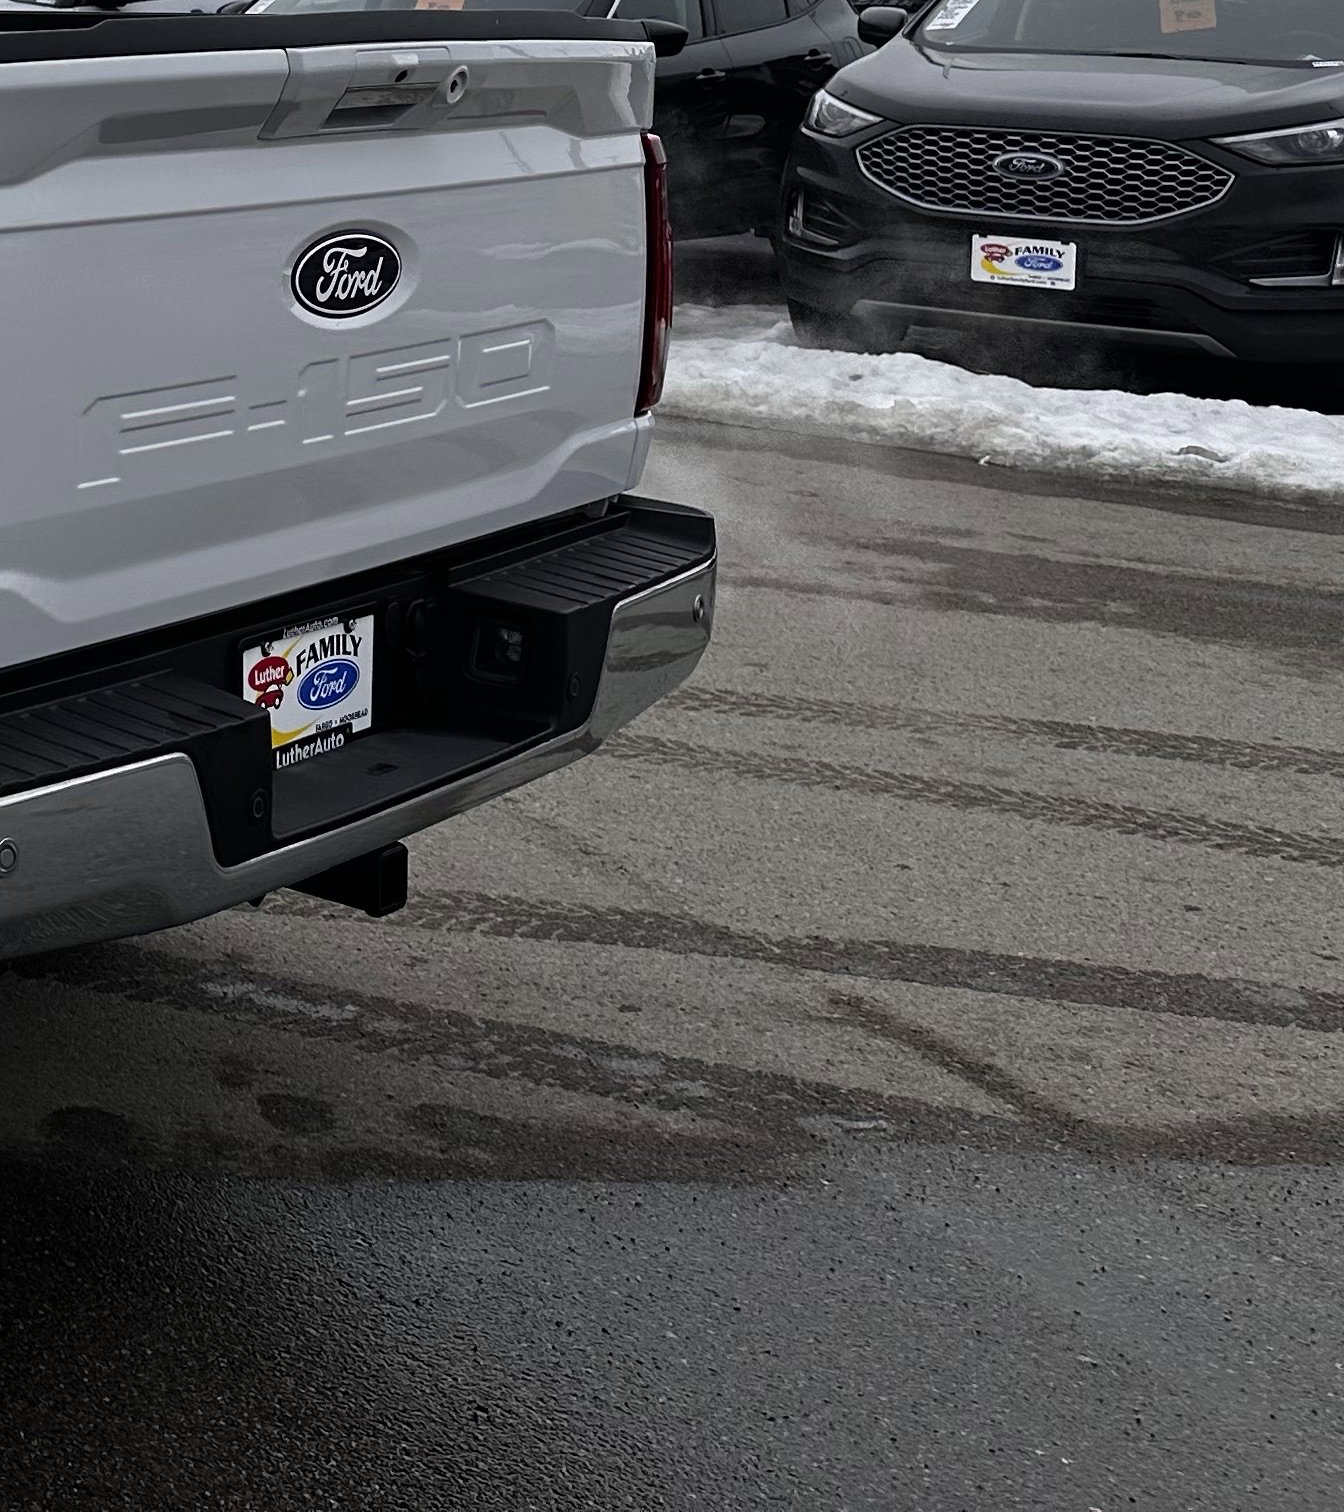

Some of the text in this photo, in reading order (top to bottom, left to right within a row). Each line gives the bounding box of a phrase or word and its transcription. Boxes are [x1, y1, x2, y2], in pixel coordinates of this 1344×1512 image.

[1008, 158, 1045, 173] Ford
[1015, 246, 1065, 259] FAMILY
[1024, 256, 1053, 269] Ford
[315, 247, 384, 303] Ford
[78, 318, 556, 489] F-150
[295, 633, 363, 677] FAMILY
[254, 664, 286, 686] Luther
[310, 666, 348, 702] Ford
[276, 732, 345, 769] LutherAuto
